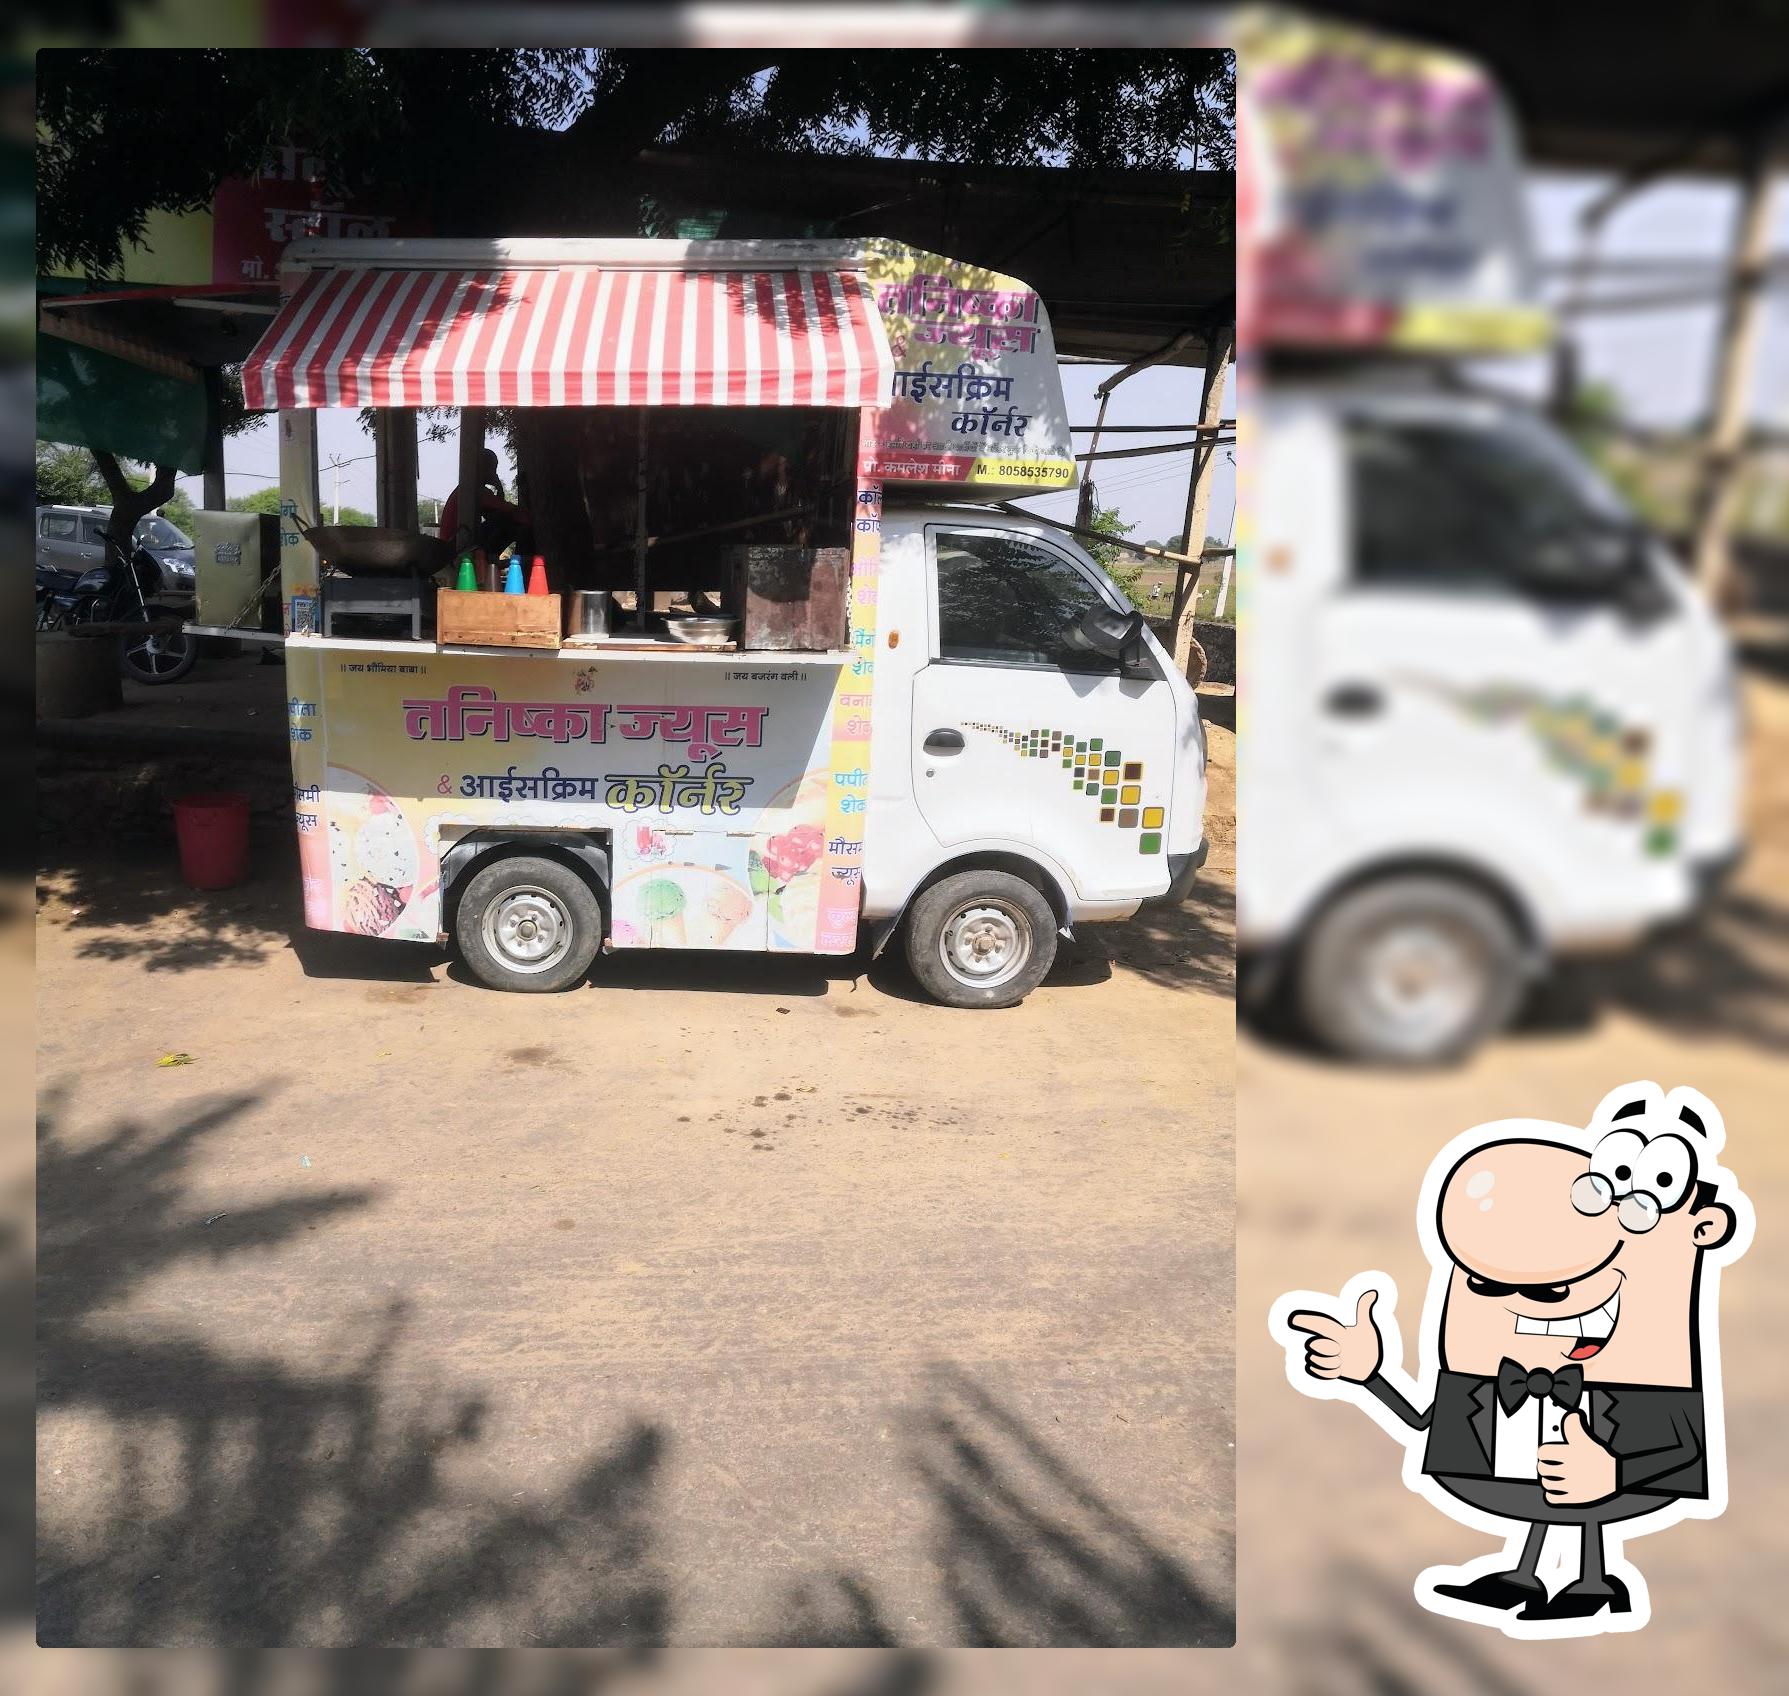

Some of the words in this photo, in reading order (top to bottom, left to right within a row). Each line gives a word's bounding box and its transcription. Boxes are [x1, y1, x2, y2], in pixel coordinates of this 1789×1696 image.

[912, 320, 1042, 361] ज्यूस
[951, 406, 1033, 437] कॉर्नर
[999, 465, 1069, 479] 8058535790
[349, 663, 364, 673] जय
[733, 672, 749, 681] जय
[402, 684, 612, 745] तनिष्का
[616, 703, 769, 764] ज्यूस
[436, 774, 453, 795] &
[459, 766, 599, 803] आईसक्रिम
[604, 762, 755, 816] कॉर्नर
